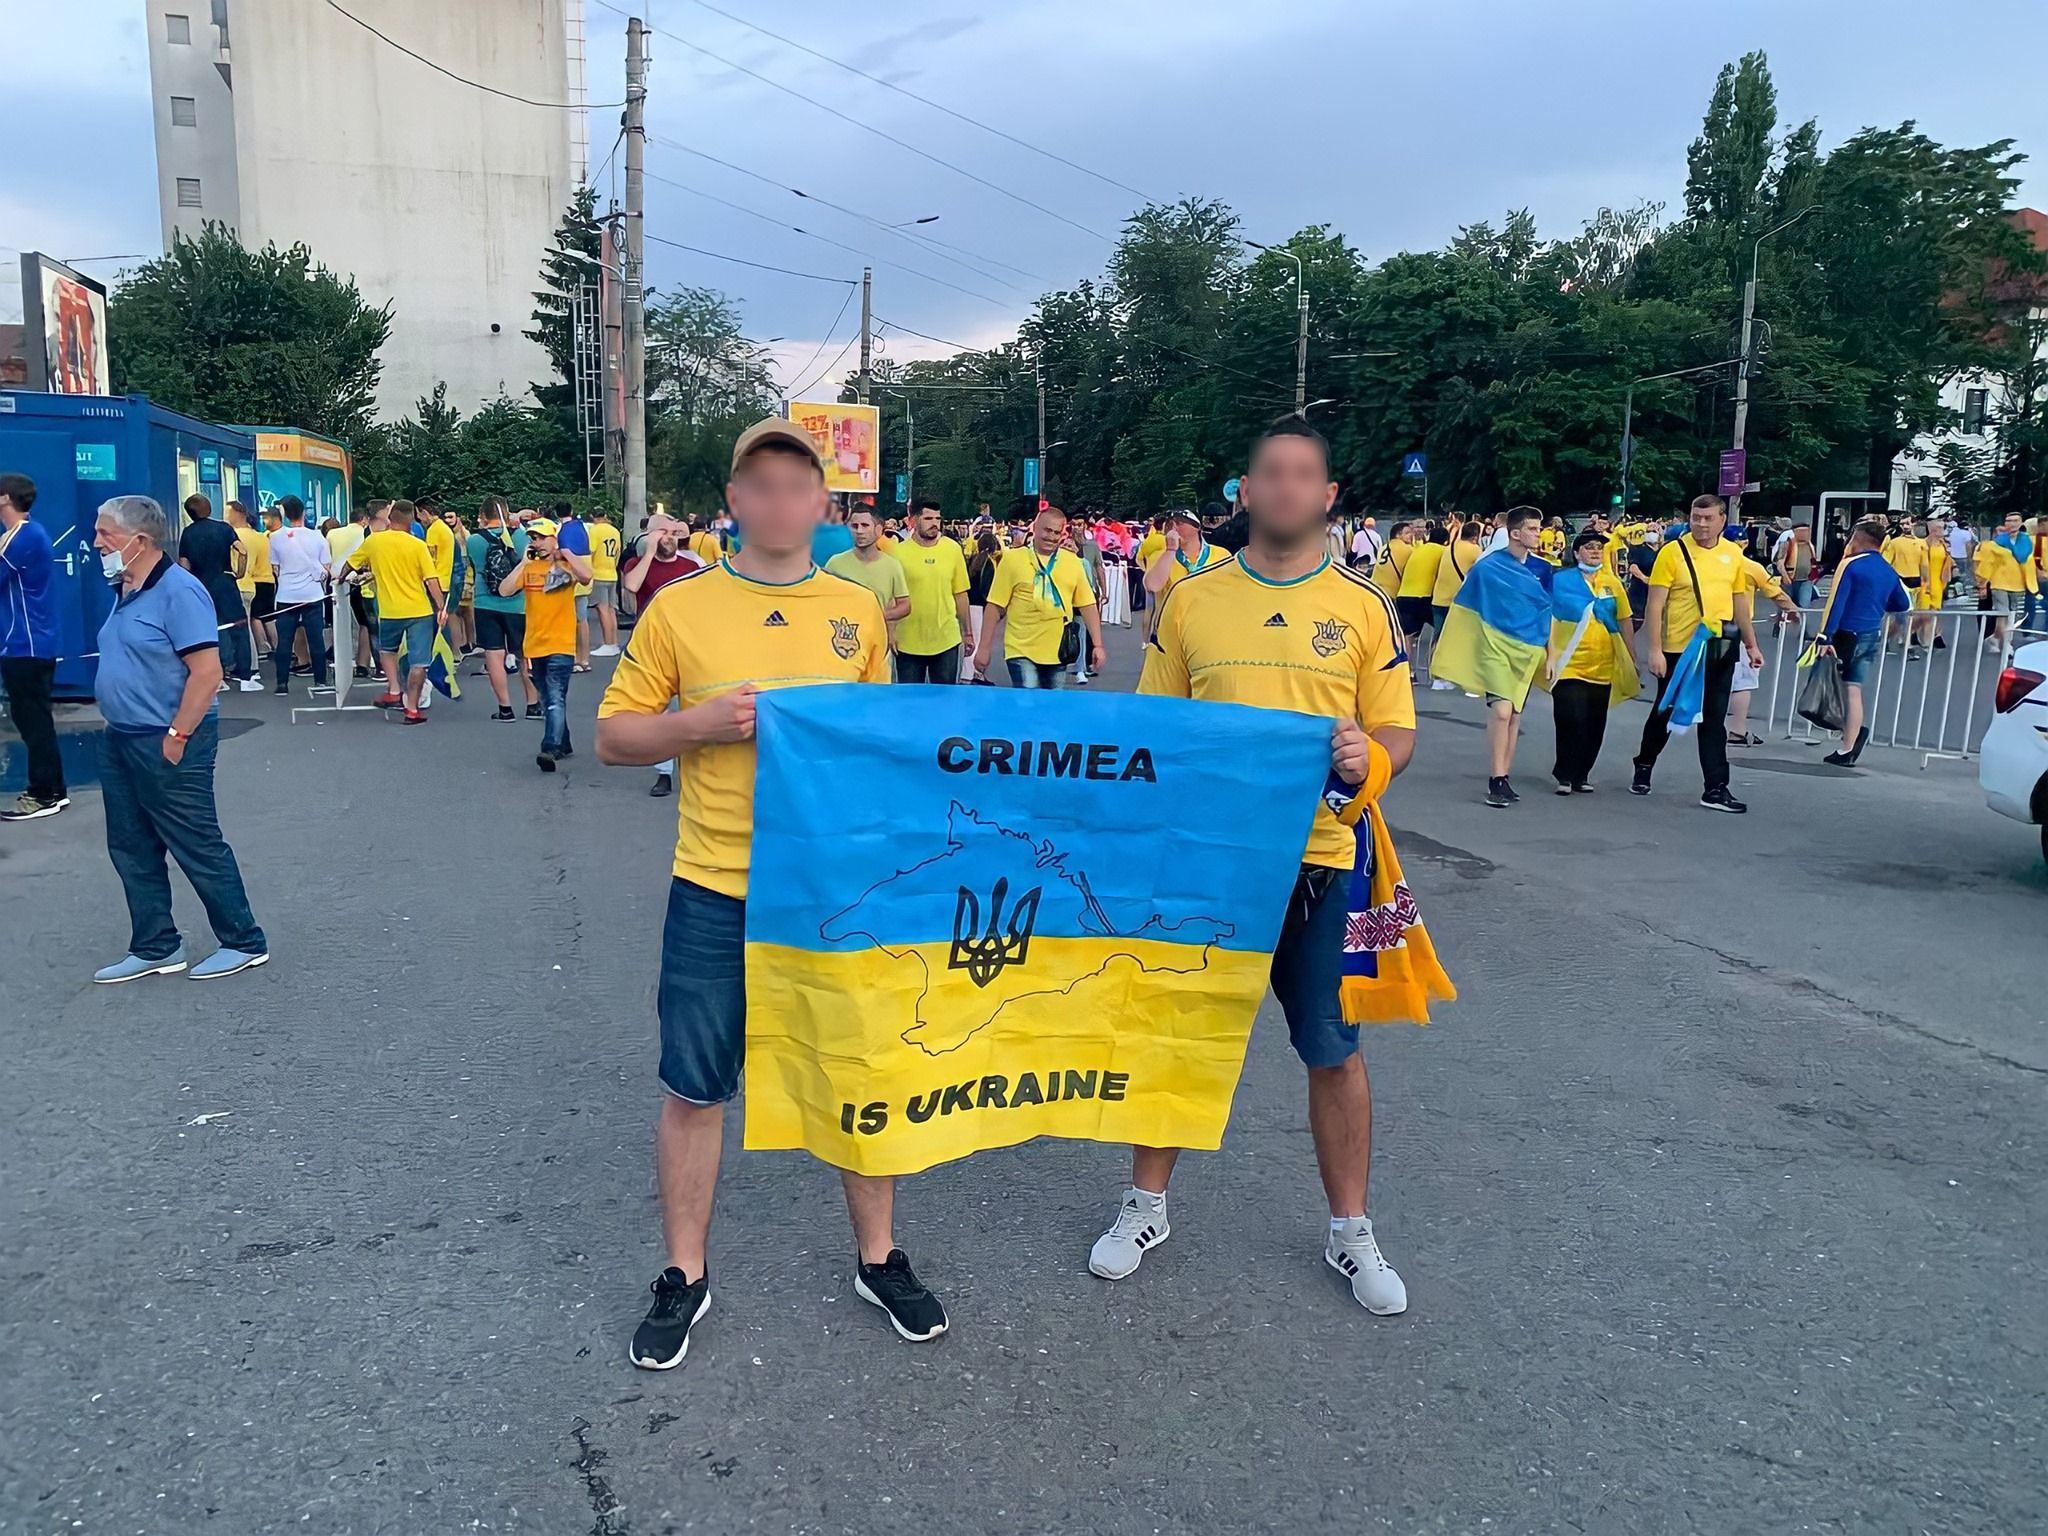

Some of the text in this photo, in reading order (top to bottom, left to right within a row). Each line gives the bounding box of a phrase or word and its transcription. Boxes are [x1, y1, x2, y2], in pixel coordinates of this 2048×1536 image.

[602, 538, 617, 557] 12
[937, 736, 1158, 784] CRIMEA
[840, 1069, 1130, 1136] IS UKRAINE
